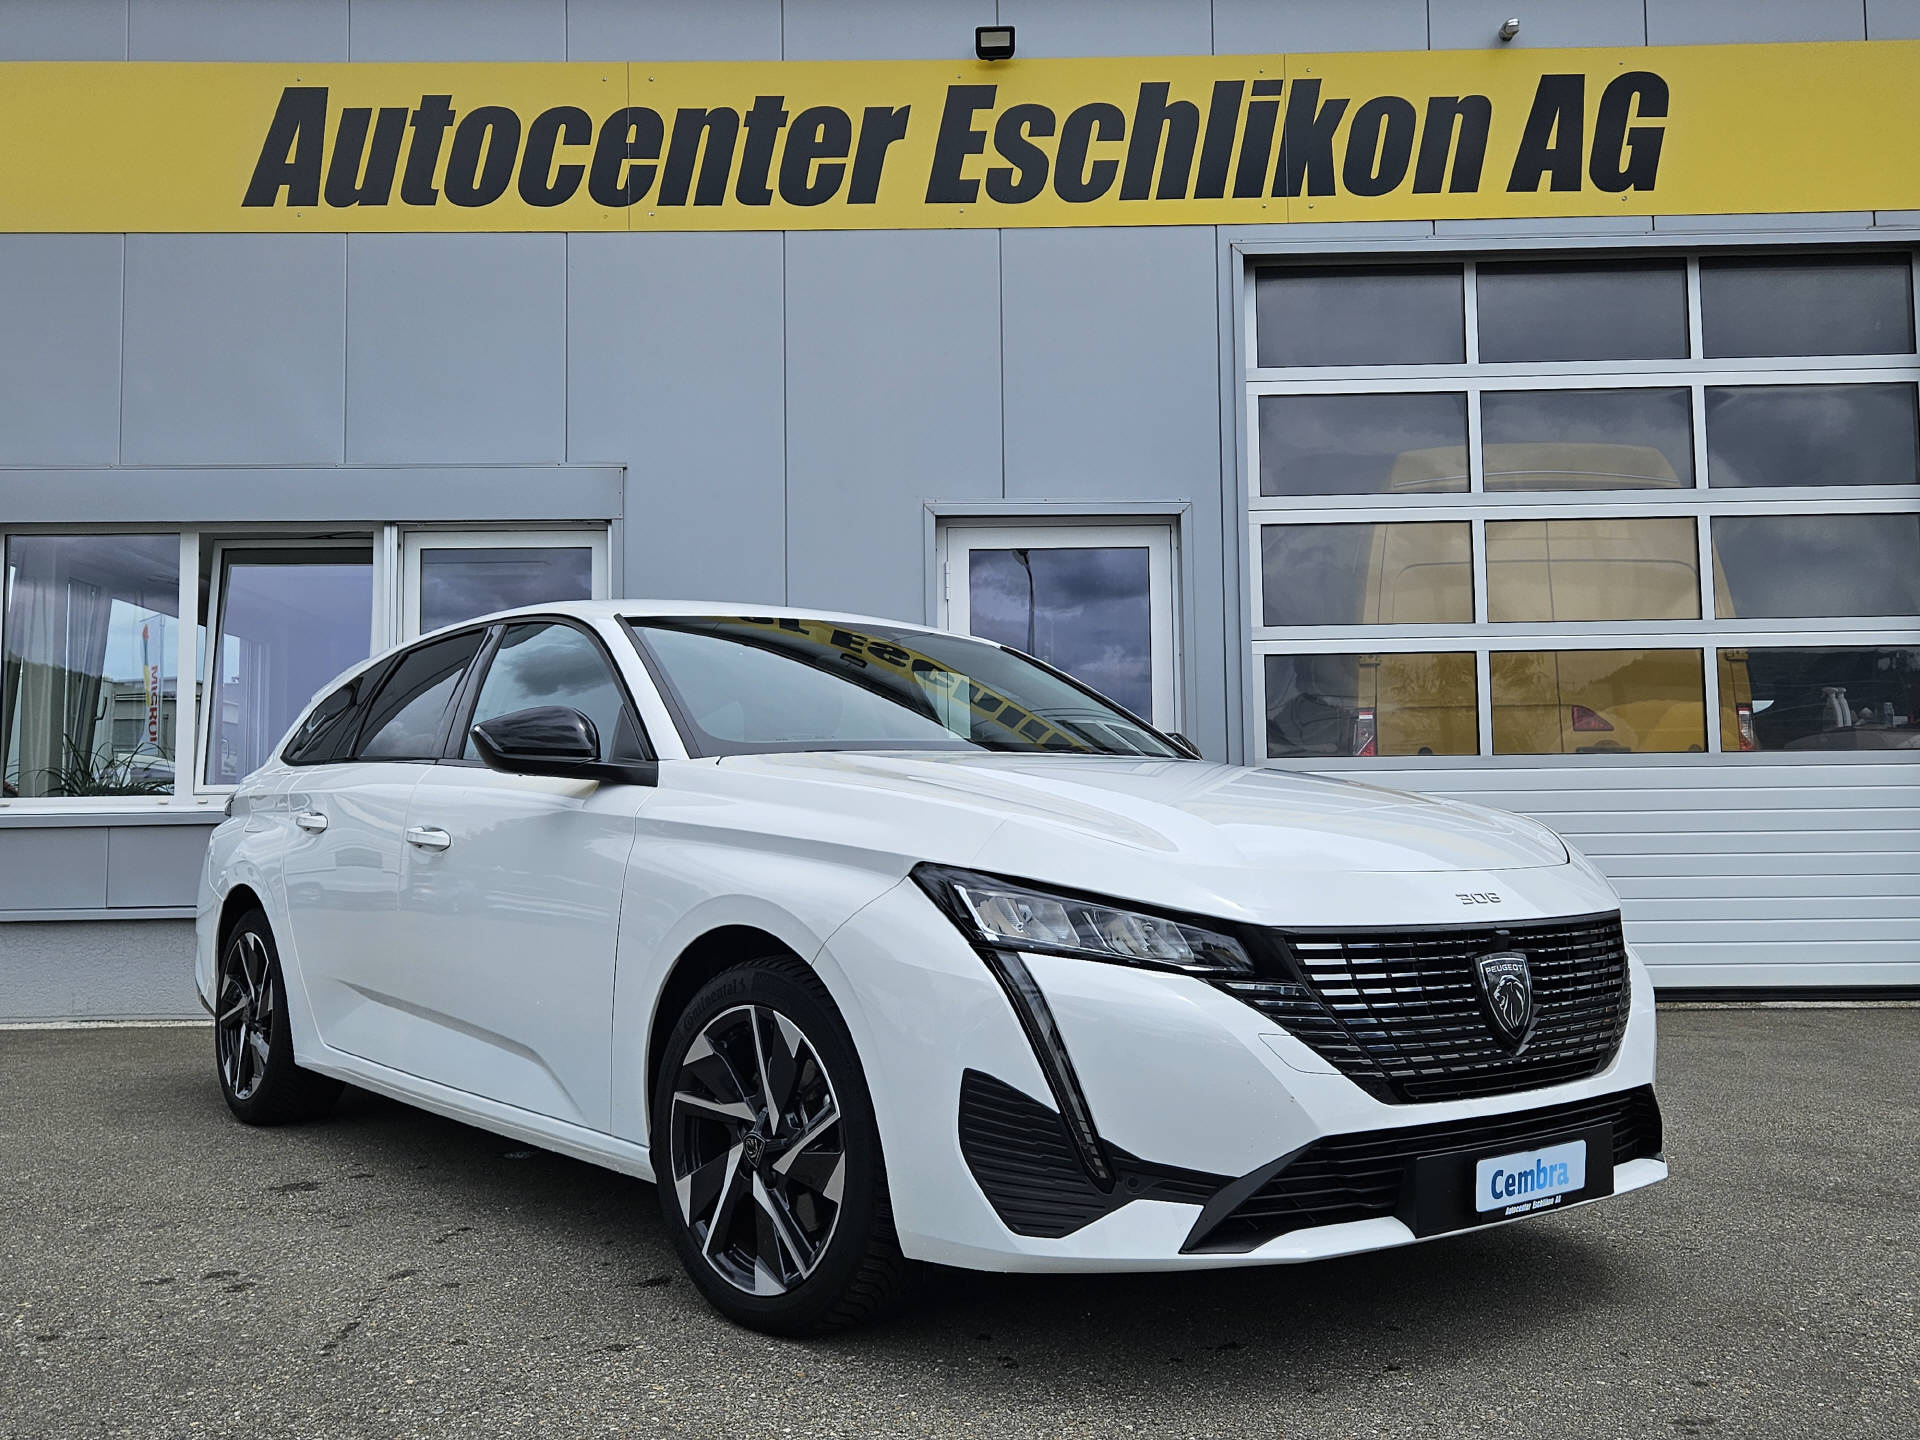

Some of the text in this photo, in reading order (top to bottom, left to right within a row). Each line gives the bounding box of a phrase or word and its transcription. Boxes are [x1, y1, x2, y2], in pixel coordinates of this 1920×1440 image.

[242, 71, 1670, 208] Autocenter Eschlikon AG
[1485, 963, 1523, 975] PEUGEOT
[1491, 1158, 1570, 1200] Cembra
